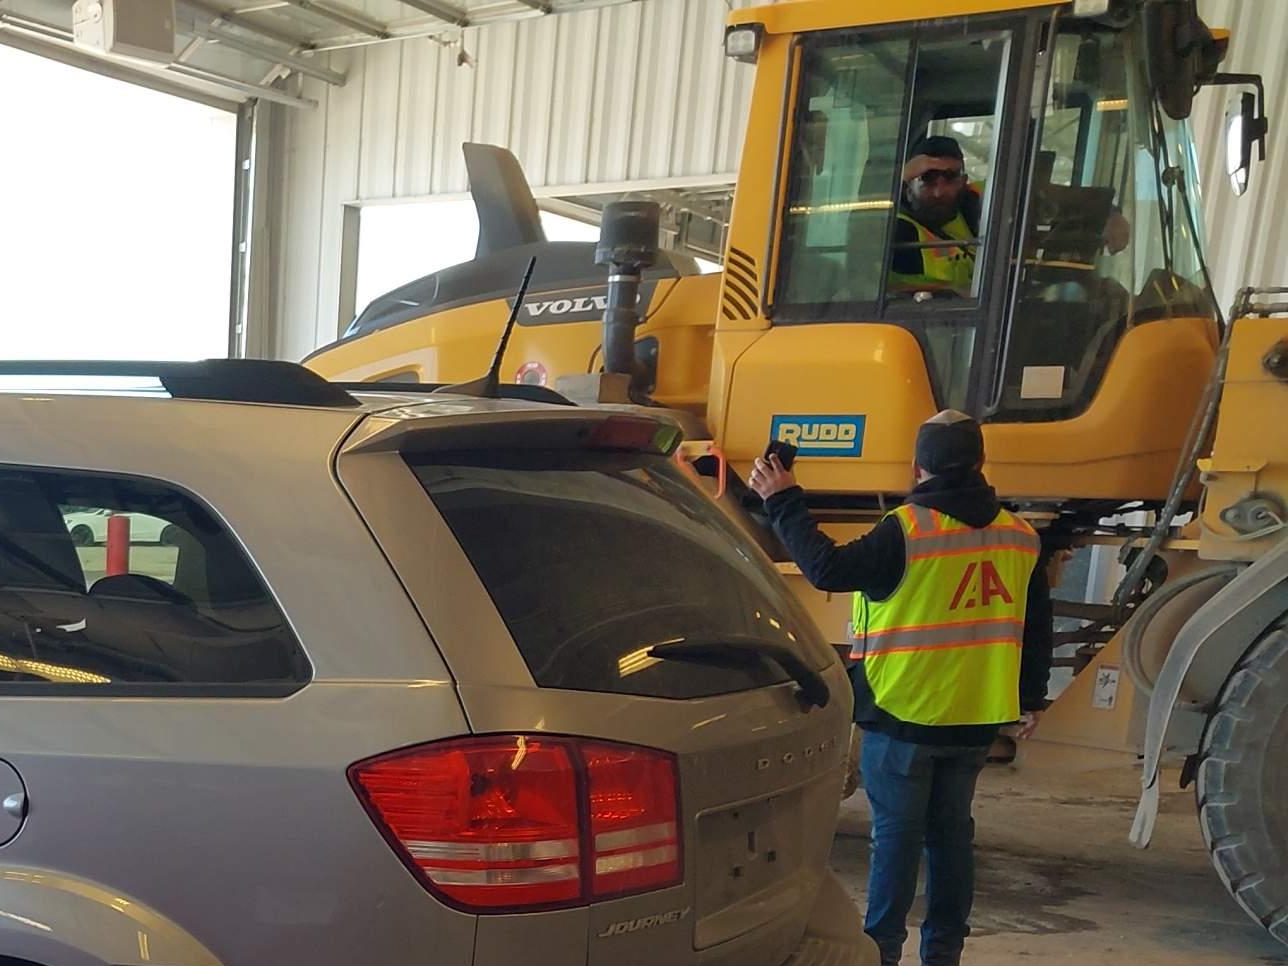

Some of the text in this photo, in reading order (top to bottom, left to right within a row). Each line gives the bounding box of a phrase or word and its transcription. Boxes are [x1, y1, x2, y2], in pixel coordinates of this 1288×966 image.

[524, 295, 640, 317] VOLV
[778, 423, 857, 449] RUDD
[598, 905, 691, 938] JOURNEY
